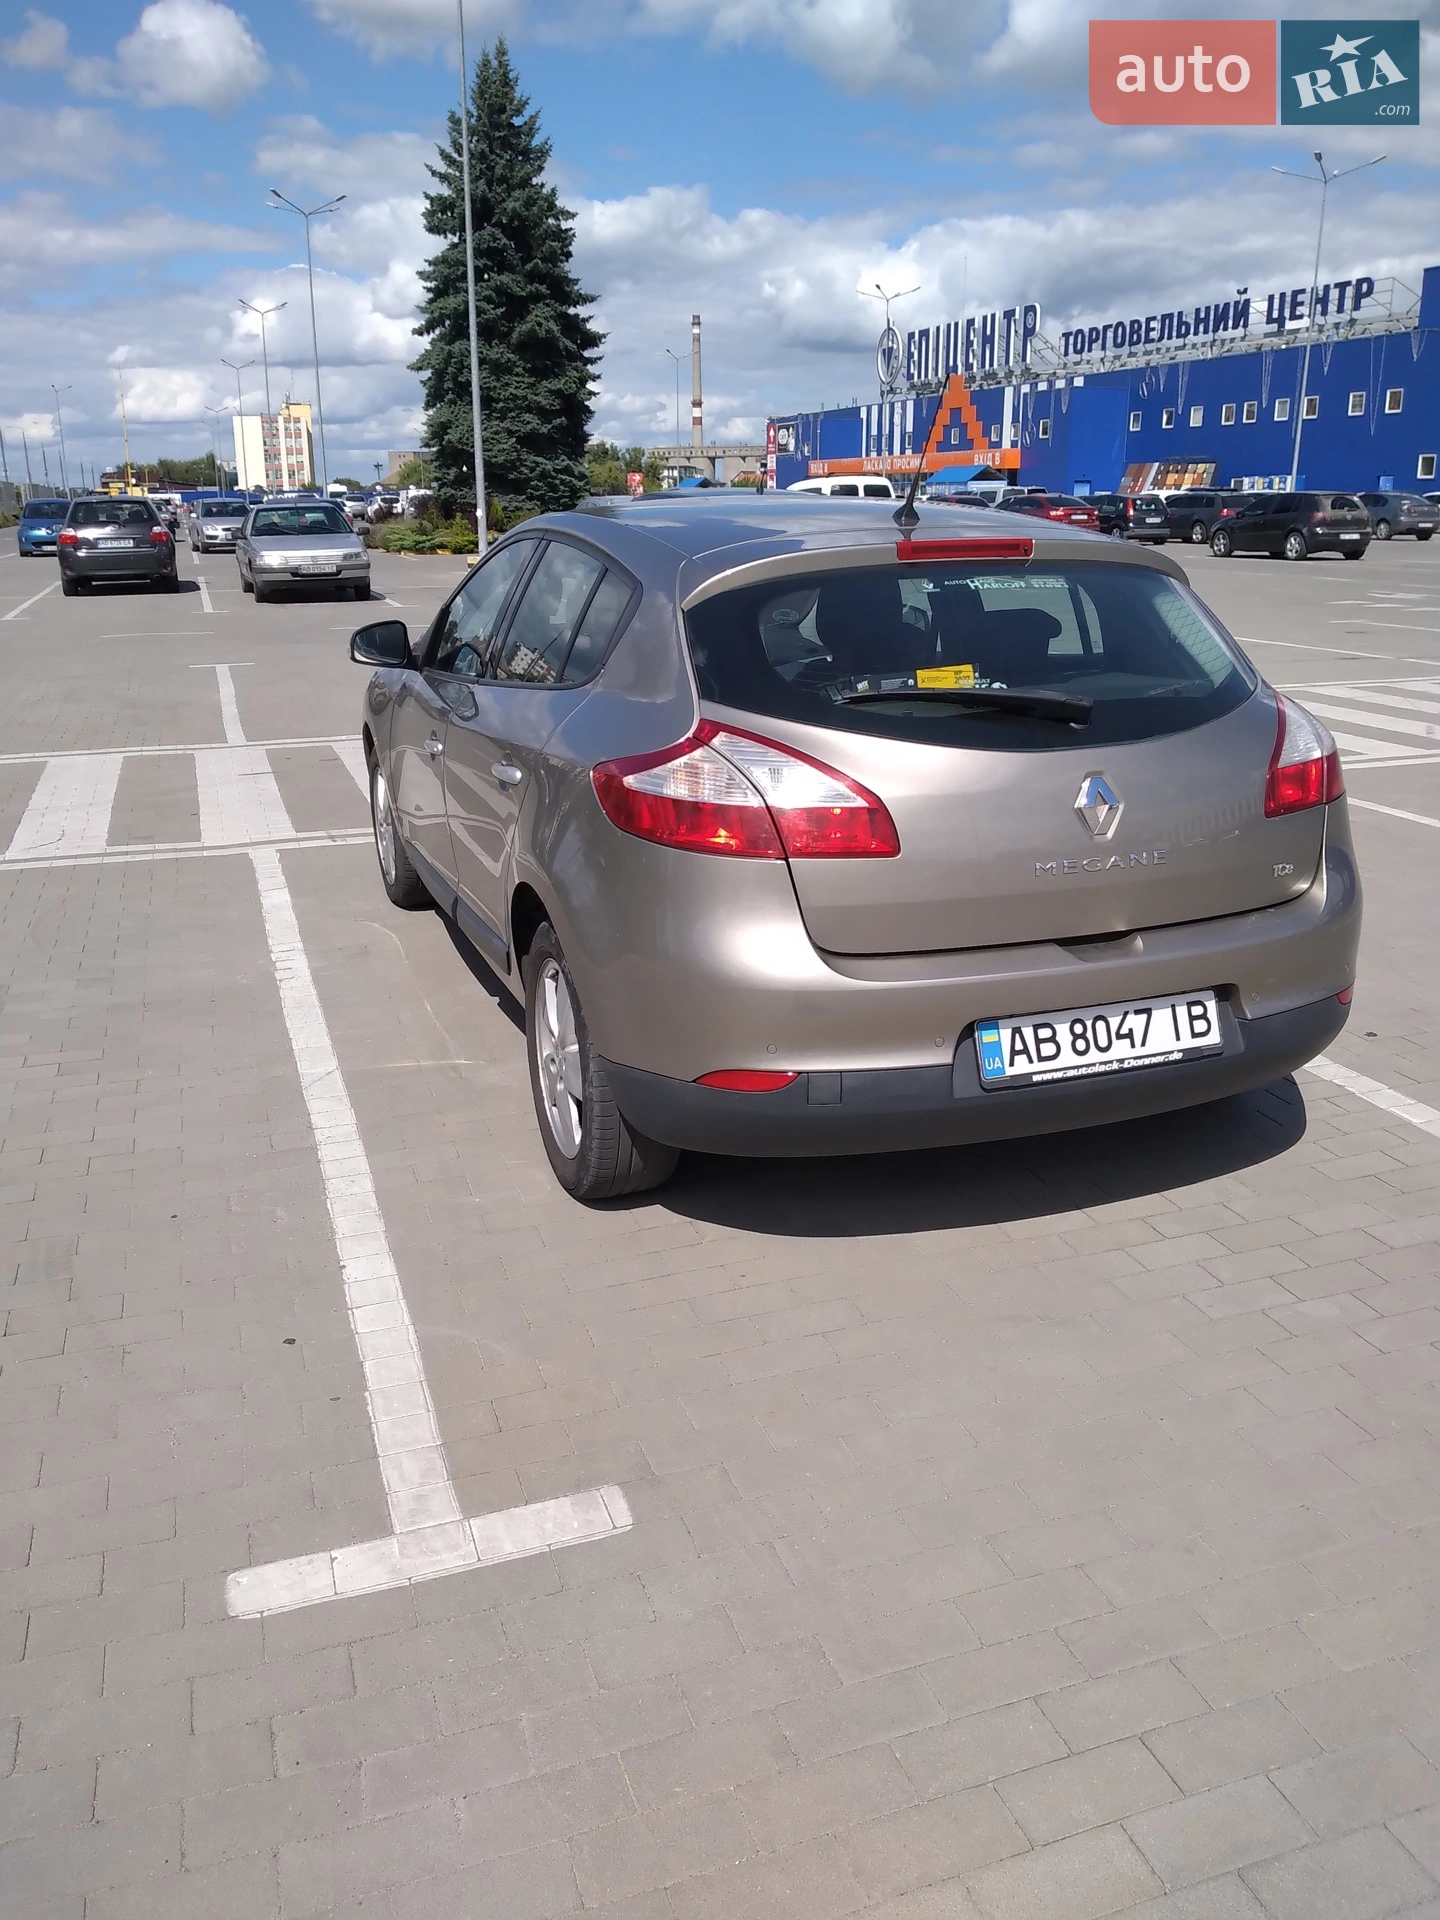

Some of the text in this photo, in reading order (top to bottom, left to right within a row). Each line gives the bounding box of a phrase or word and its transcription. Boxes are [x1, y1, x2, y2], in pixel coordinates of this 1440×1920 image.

[1061, 276, 1375, 357] ТОРГОВЕЛЬНИЙ ЦЕНТР
[906, 302, 1041, 382] ЕПІЦЕНТР
[862, 459, 891, 471] ЛАСКАО
[974, 453, 992, 467] ВХІД
[1034, 850, 1168, 878] MEGANE
[1008, 1000, 1212, 1067] AB 8047 IB
[984, 1057, 1003, 1071] UA
